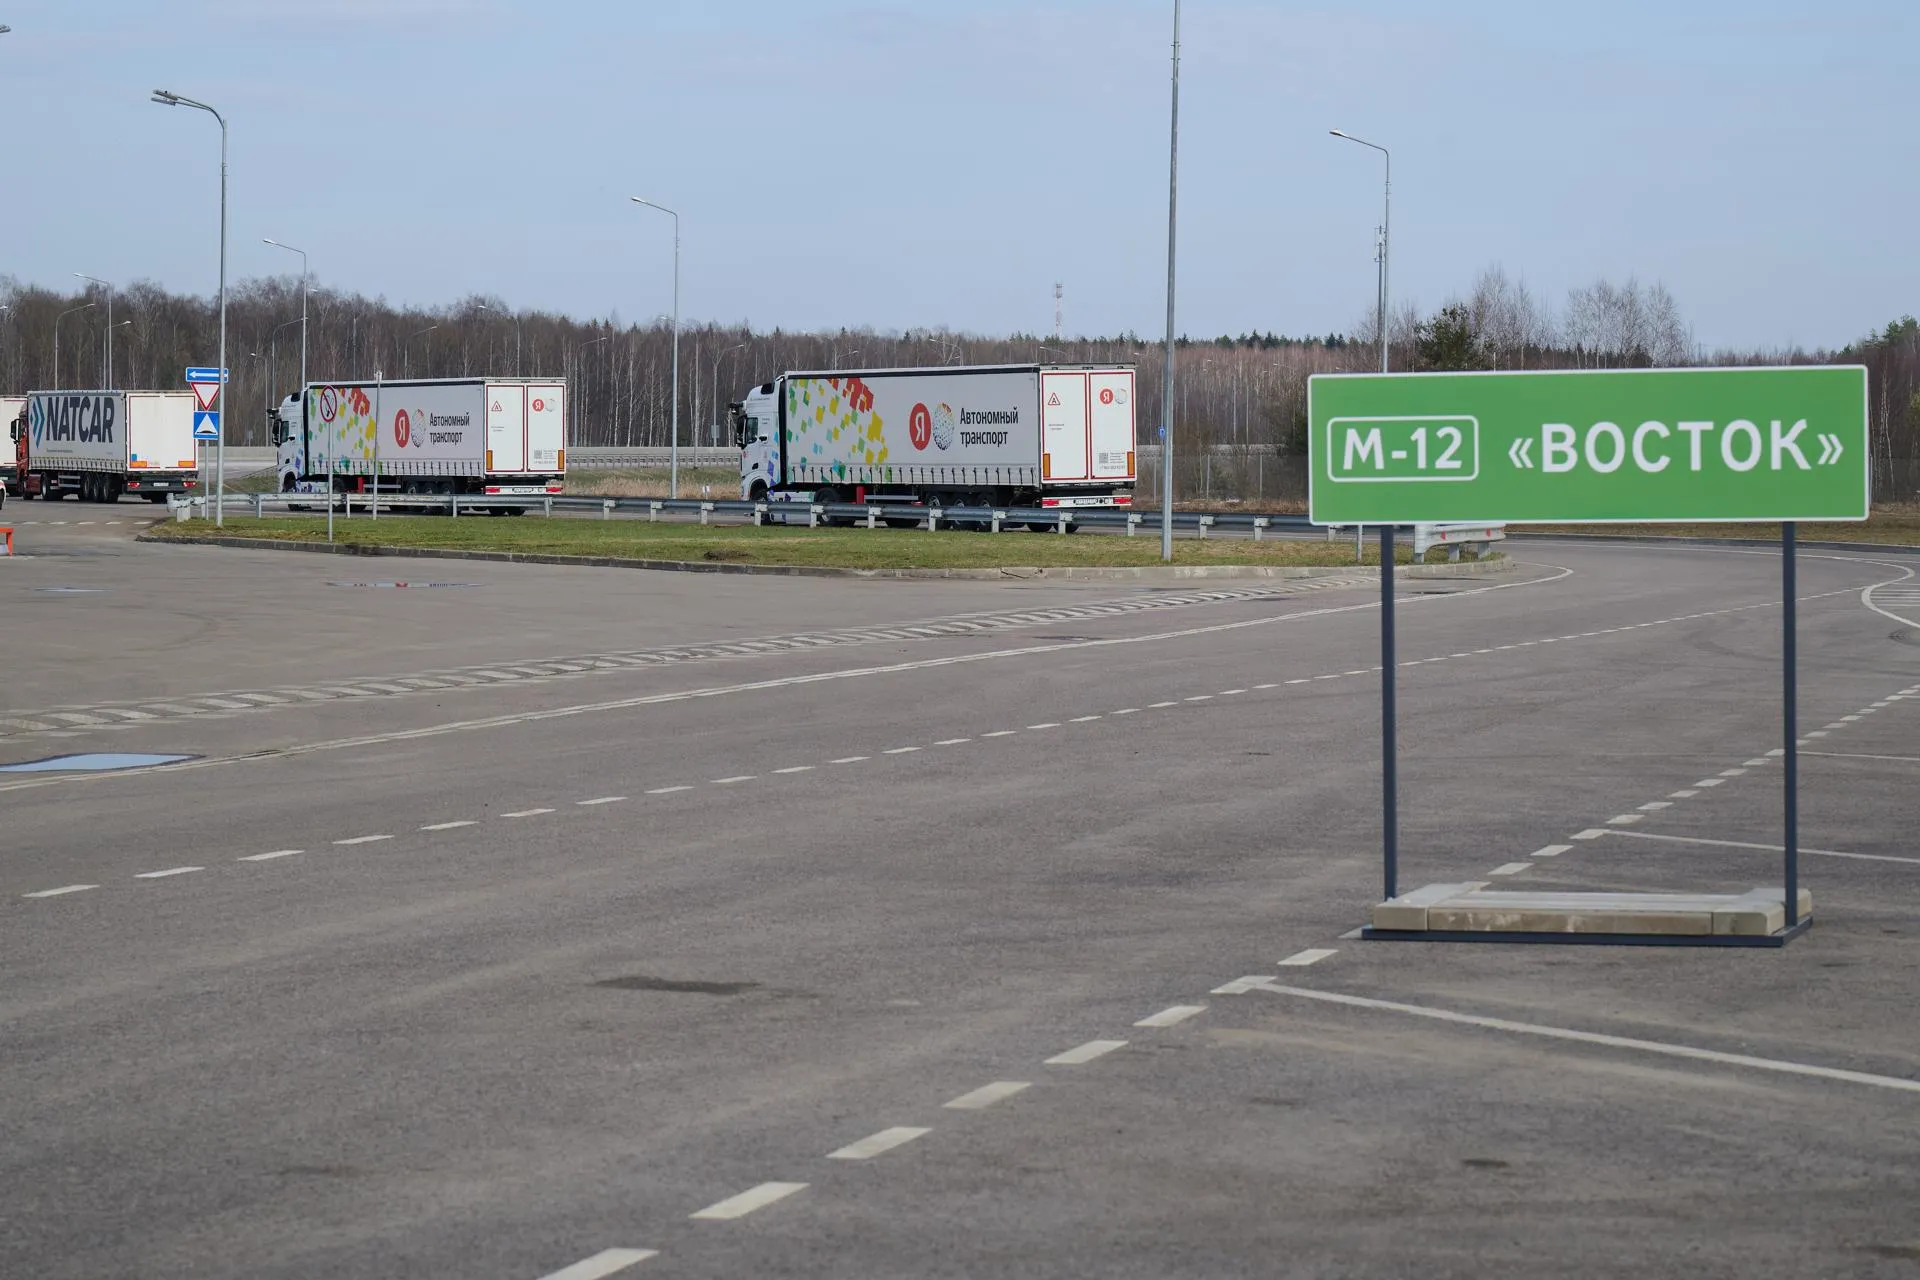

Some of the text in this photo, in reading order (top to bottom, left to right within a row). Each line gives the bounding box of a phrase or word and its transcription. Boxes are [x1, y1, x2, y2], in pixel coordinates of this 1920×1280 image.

[46, 396, 115, 443] NATCAR
[429, 412, 470, 427] Автономный
[960, 406, 1019, 425] Автономный
[398, 416, 406, 441] Я
[429, 431, 463, 446] транспорт
[915, 413, 925, 442] Я
[960, 430, 1008, 448] транспорт
[1343, 419, 1844, 473] М-12 «ВОСТОК»
